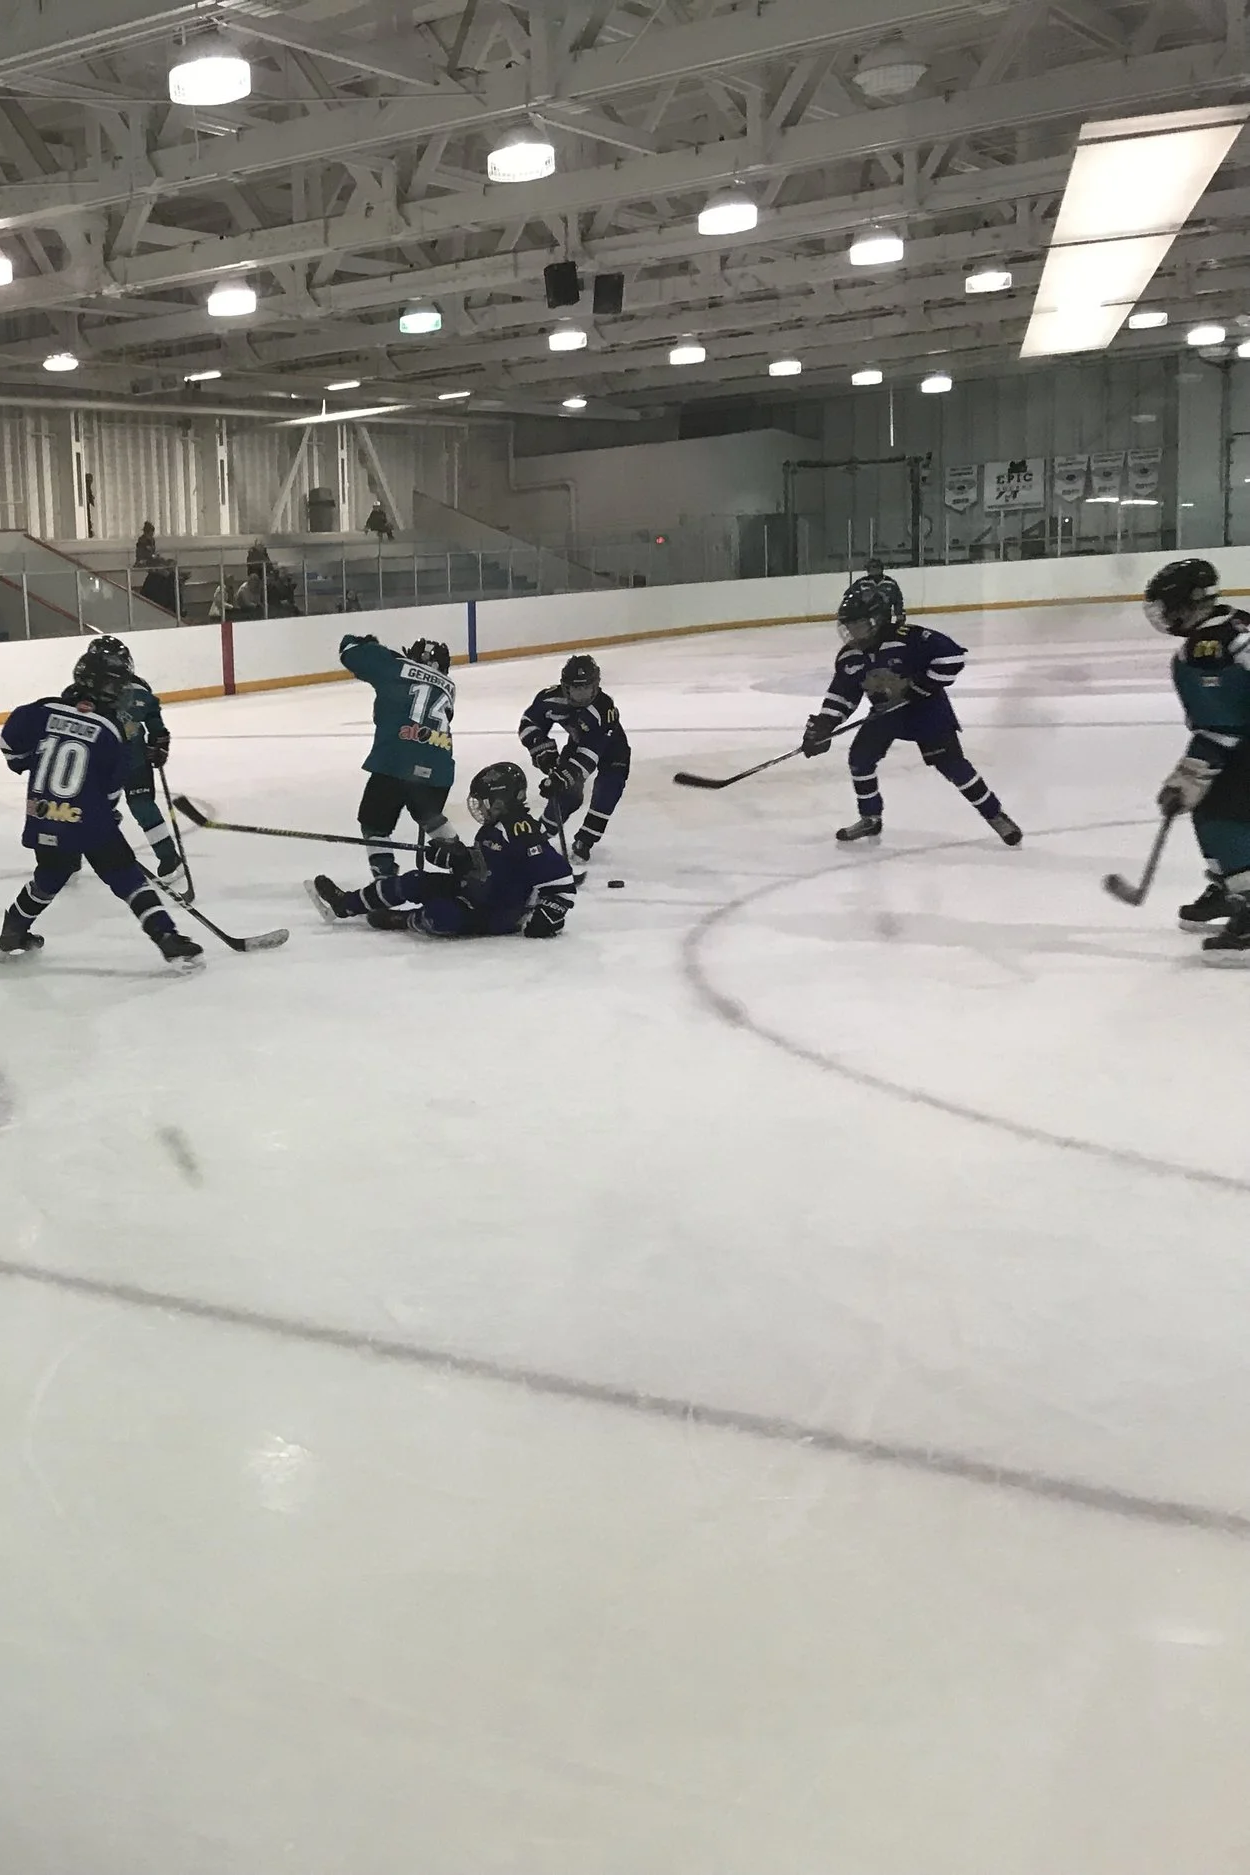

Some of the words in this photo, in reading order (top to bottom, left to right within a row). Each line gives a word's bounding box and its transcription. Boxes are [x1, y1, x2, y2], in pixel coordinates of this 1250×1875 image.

[996, 473, 1034, 485] EPIC
[409, 683, 454, 736] 14
[32, 735, 90, 799] 10
